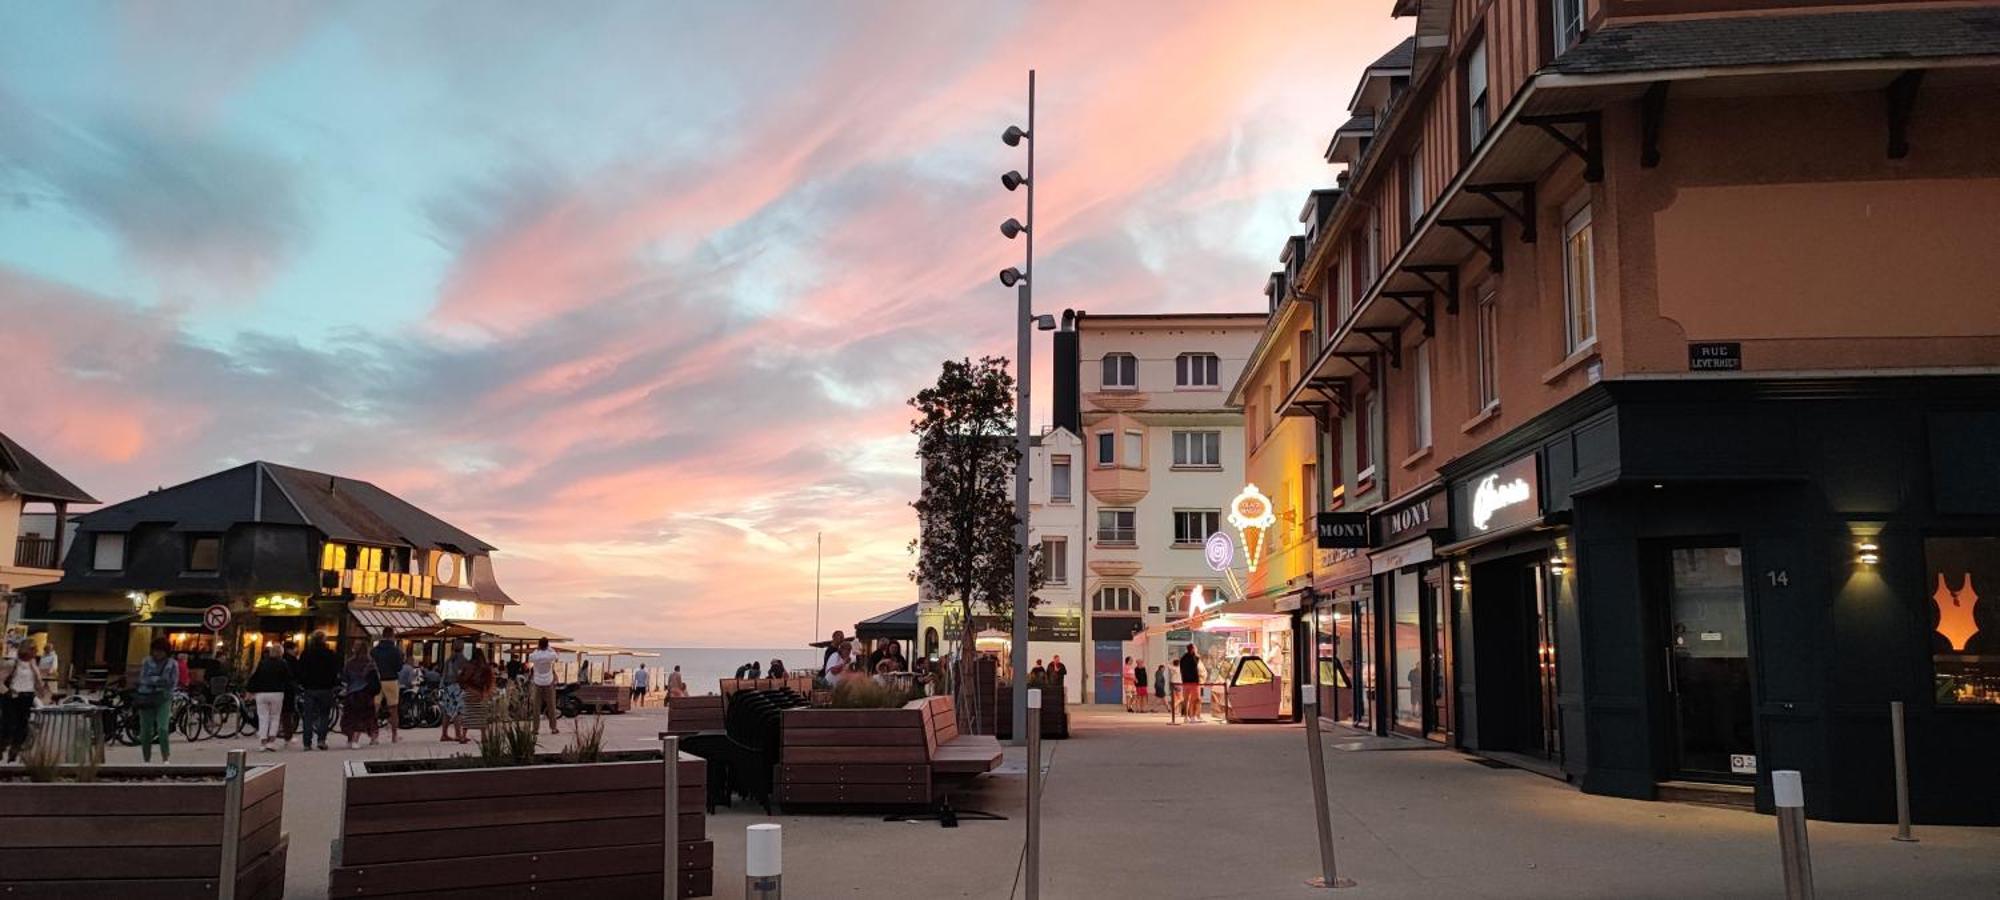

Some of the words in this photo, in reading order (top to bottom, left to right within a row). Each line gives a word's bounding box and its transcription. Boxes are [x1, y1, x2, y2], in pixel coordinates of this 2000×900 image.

[1702, 346, 1728, 356] RUE
[1391, 499, 1432, 534] MONY
[1320, 523, 1366, 537] MONY
[1766, 570, 1789, 586] 14
